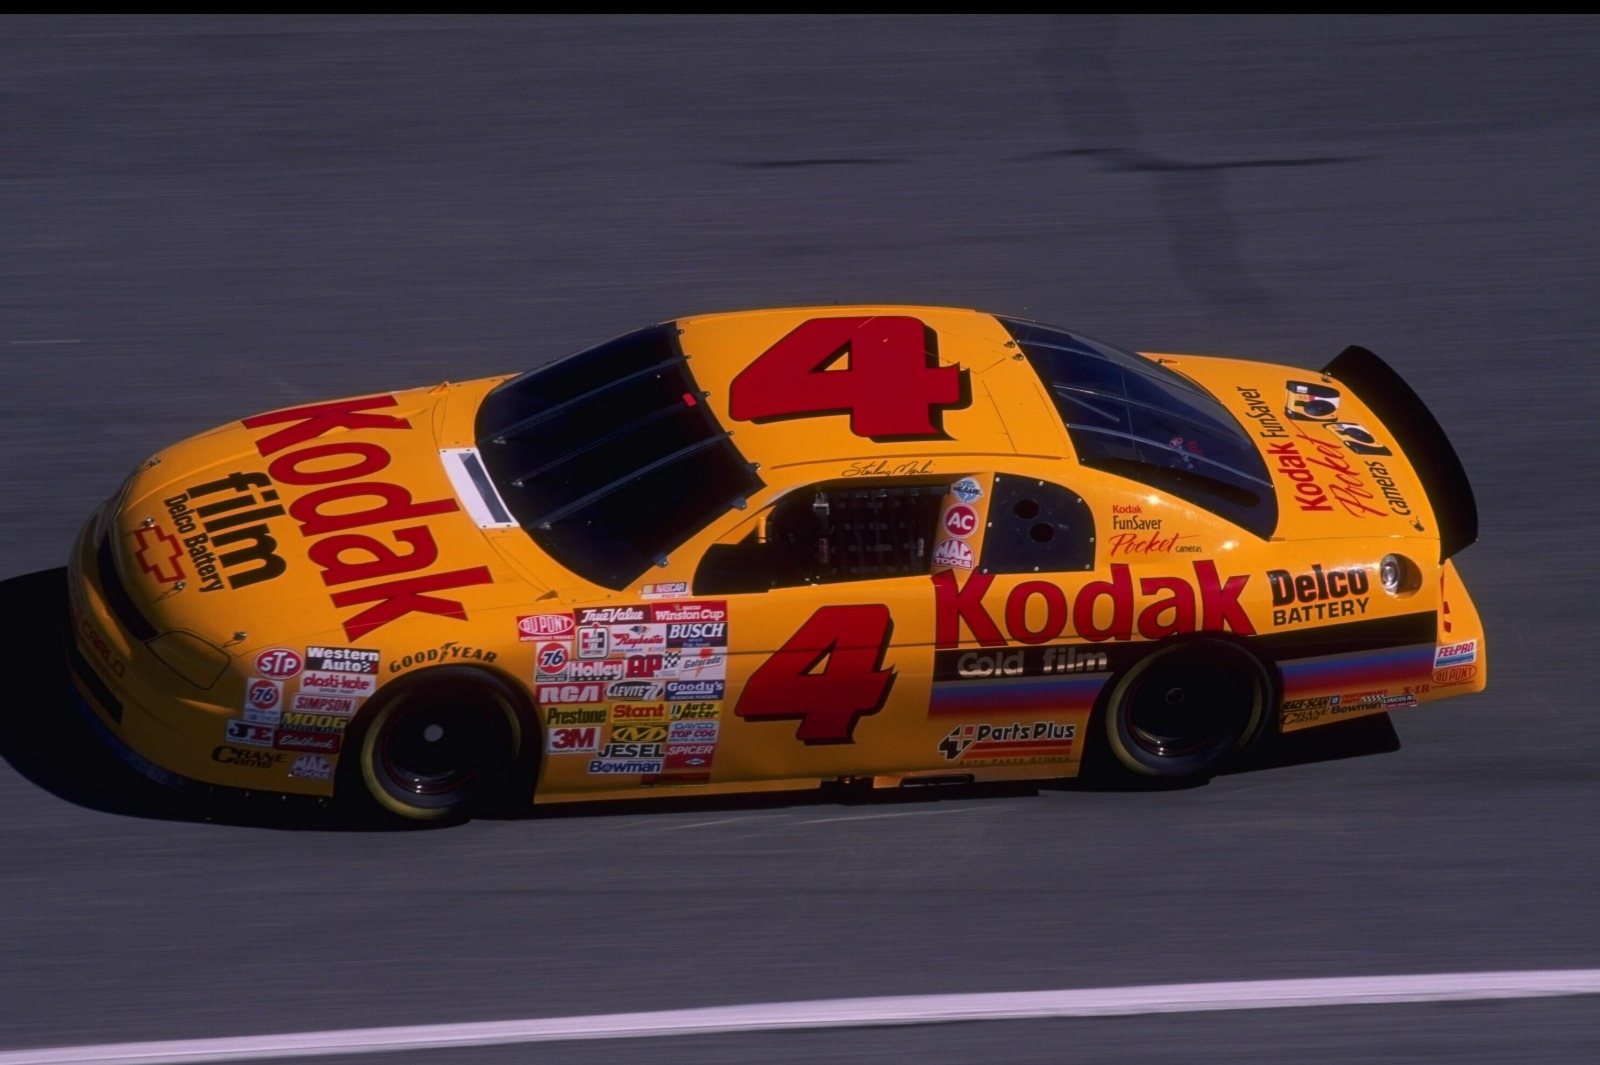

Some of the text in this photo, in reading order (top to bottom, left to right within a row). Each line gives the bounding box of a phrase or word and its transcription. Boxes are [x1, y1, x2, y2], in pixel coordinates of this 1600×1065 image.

[729, 316, 973, 443] 4
[1236, 386, 1289, 438] FunSaver
[1284, 413, 1390, 518] Pocket
[1266, 442, 1334, 512] Kodak
[1364, 461, 1412, 516] cameras
[1112, 505, 1142, 514] Kodak
[240, 394, 494, 643] Kodak
[947, 512, 974, 530] AC
[1112, 515, 1162, 530] FunSaver
[186, 471, 287, 590] film
[163, 492, 225, 593] Delco Battery
[936, 541, 971, 560] MAC
[1108, 531, 1202, 557] Pocket cameras
[935, 557, 971, 568] TOOLS
[1266, 563, 1370, 608] Delco
[931, 560, 1258, 649] Kodak
[1272, 597, 1370, 627] BATTERY
[655, 609, 724, 621] Winston Cup
[668, 623, 725, 639] BUSCH
[260, 651, 297, 674] STP
[307, 647, 379, 661] Western
[543, 650, 565, 667] 76
[683, 656, 721, 669] Gatorade
[957, 647, 1108, 678] Gold film
[321, 660, 362, 672] Auto
[570, 661, 623, 680] Holley
[625, 654, 662, 678] AP
[734, 604, 899, 746] 4
[253, 688, 275, 703] 76
[539, 685, 600, 703] RCA
[667, 681, 724, 695] Goody's
[1402, 684, 1430, 695] X-1R
[296, 697, 352, 712] SIMPSON
[685, 703, 714, 711] Auto
[1384, 694, 1414, 704] LINCOLN
[547, 707, 607, 724] Prestone
[613, 704, 665, 718] Stant
[681, 710, 719, 719] Meter
[1331, 702, 1382, 714] Bowman
[282, 713, 349, 728] MOOG
[228, 722, 273, 741] JE
[552, 728, 595, 749] 3M
[671, 730, 693, 738] TOP
[976, 722, 1076, 741] Parts Plus
[211, 745, 287, 764] CRANE
[598, 744, 666, 758] JESEL
[667, 745, 714, 756] SPICER
[589, 760, 660, 773] Bowman
[991, 758, 1025, 766] PARTS
